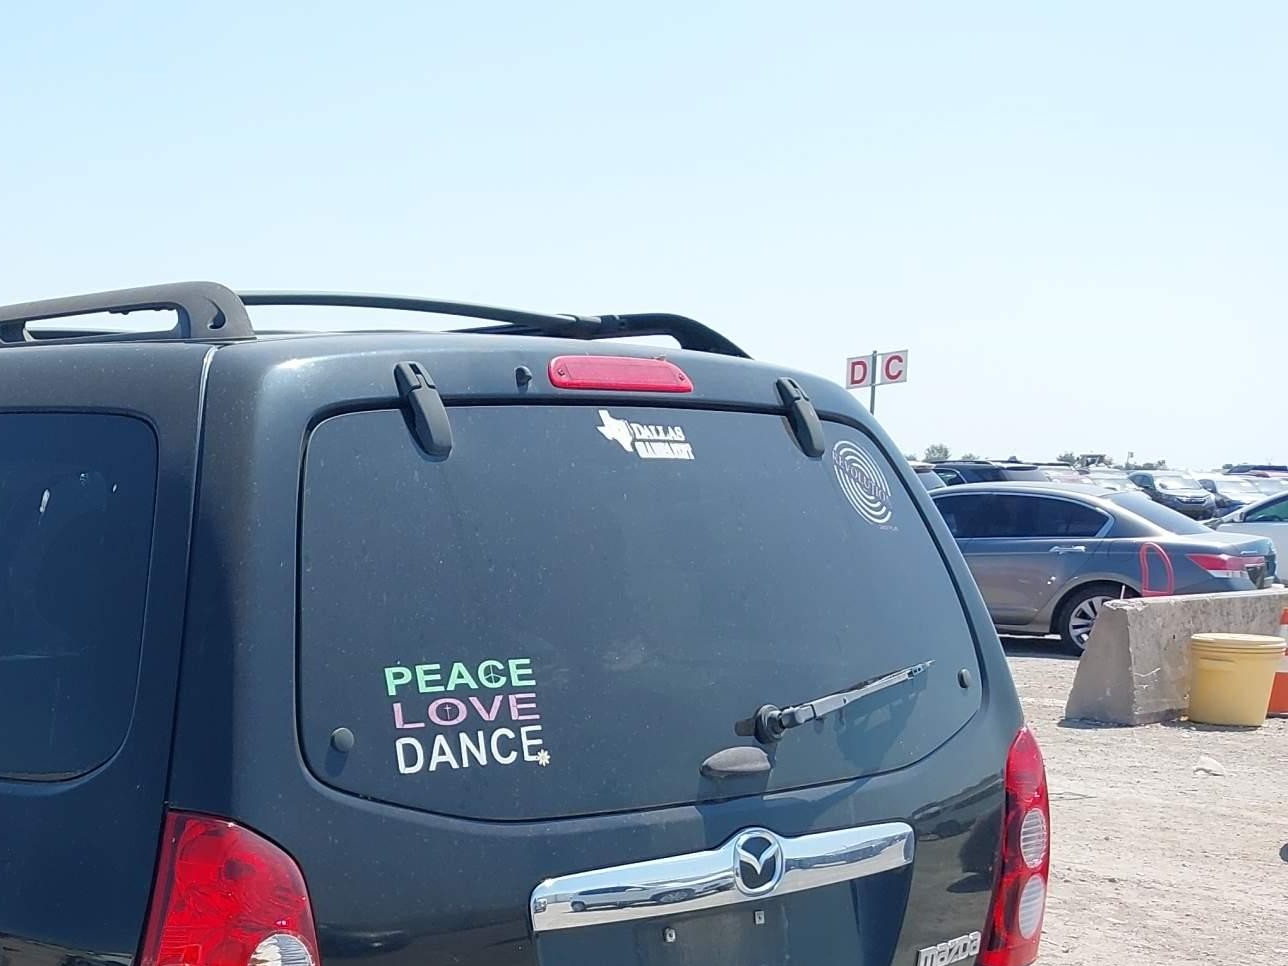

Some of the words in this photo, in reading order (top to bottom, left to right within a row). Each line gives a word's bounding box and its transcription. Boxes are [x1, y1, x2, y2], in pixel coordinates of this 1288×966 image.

[850, 360, 867, 385] D
[885, 355, 903, 380] C
[630, 423, 686, 441] DALLAS
[384, 658, 537, 697] PEACE
[392, 693, 541, 729] LOVE
[395, 725, 544, 775] DANCE
